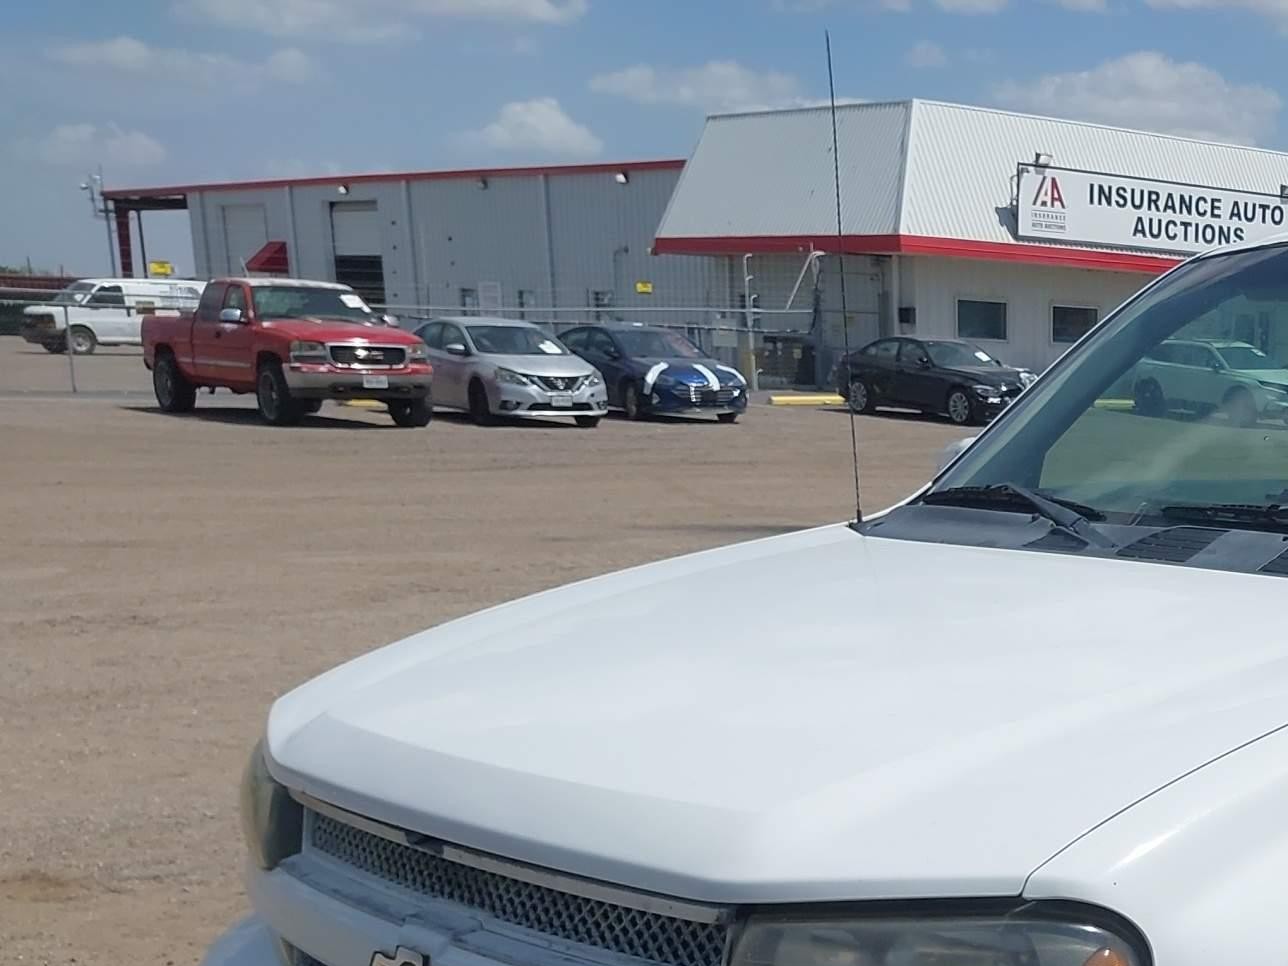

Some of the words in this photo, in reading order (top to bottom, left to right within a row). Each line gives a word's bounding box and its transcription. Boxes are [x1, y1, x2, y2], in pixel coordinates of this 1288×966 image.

[1088, 182, 1222, 219] INSURANCE
[1229, 201, 1285, 226] AUTO
[1132, 216, 1245, 245] AUCTIONS
